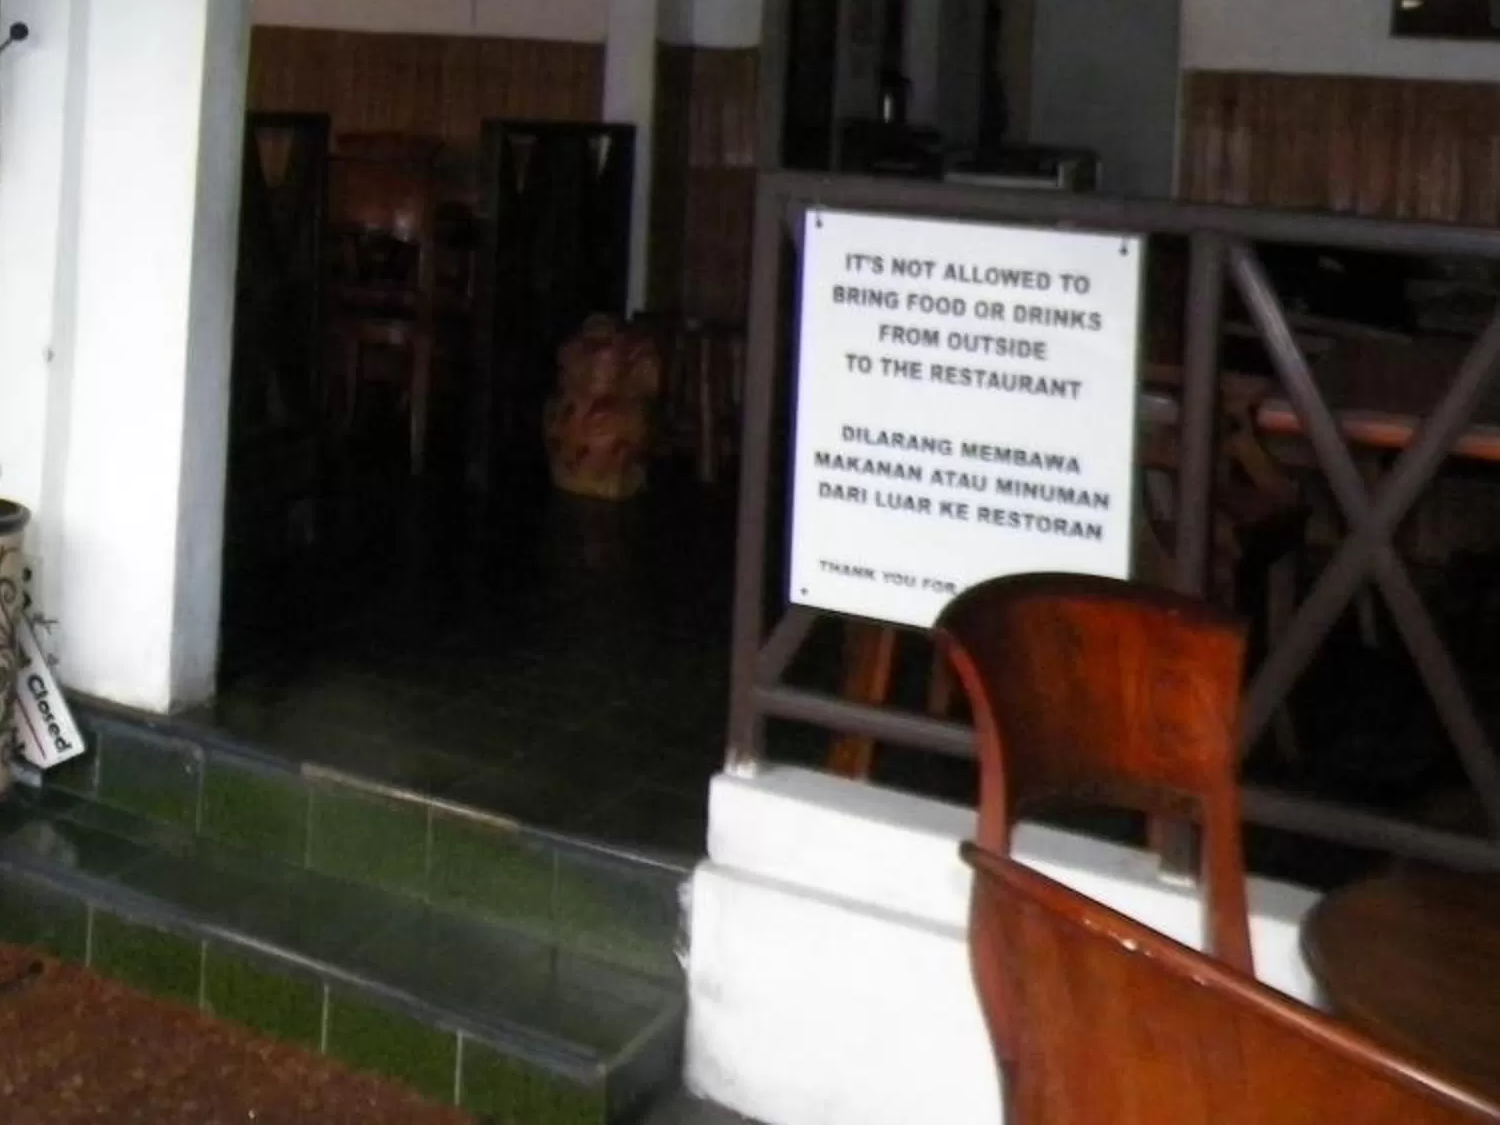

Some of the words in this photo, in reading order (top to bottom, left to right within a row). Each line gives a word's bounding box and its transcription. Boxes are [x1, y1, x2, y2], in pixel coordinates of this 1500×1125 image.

[845, 253, 884, 275] IT'S
[891, 257, 936, 279] NOT
[943, 263, 1051, 291] ALLOWED
[1059, 273, 1091, 294] TO
[832, 285, 899, 309] BRING
[906, 292, 966, 316] FOOD
[974, 301, 1005, 320] OR
[1012, 304, 1102, 331] DRINKS
[879, 323, 940, 347] FROM
[947, 331, 1047, 361] OUTSIDE
[845, 353, 873, 373] TO
[880, 357, 922, 380] THE
[930, 363, 1082, 400] RESTAURANT
[841, 425, 953, 456] DILARANG
[960, 441, 1081, 475] MEMBAWA
[814, 451, 922, 482] MAKANAN
[931, 469, 987, 492] ATAU
[996, 477, 1109, 510] MINUMAN
[818, 481, 867, 504] DARI
[875, 490, 931, 515] LUAR
[938, 501, 970, 521] KE
[977, 506, 1103, 541] RESTORAN
[819, 560, 876, 581] THANK
[883, 572, 916, 588] YOU
[921, 577, 958, 595] FOR
[26, 675, 72, 753] Closed
